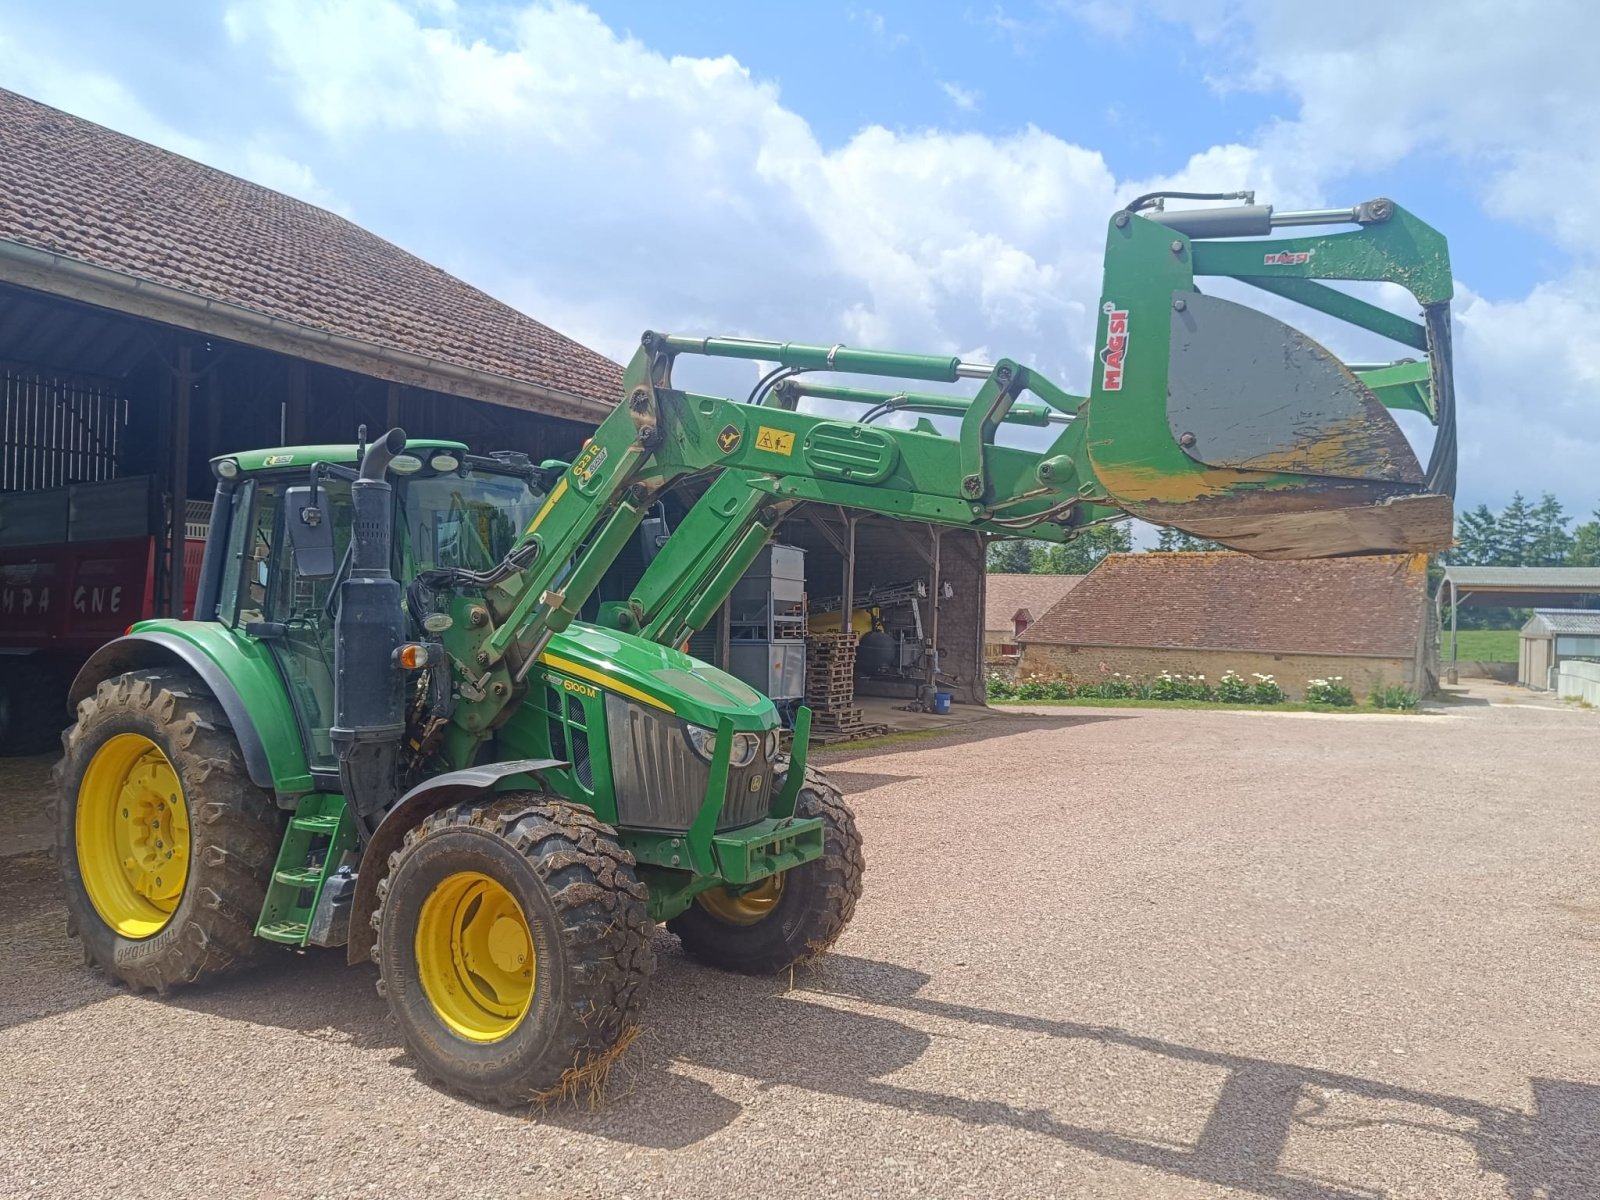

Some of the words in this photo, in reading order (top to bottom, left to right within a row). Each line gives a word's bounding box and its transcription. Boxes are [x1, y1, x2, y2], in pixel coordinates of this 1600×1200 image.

[1265, 253, 1308, 264] MAGSI
[1104, 311, 1127, 389] MAGSI
[573, 454, 591, 475] 623
[589, 445, 600, 455] R
[564, 680, 586, 694] 6100
[587, 687, 596, 698] M
